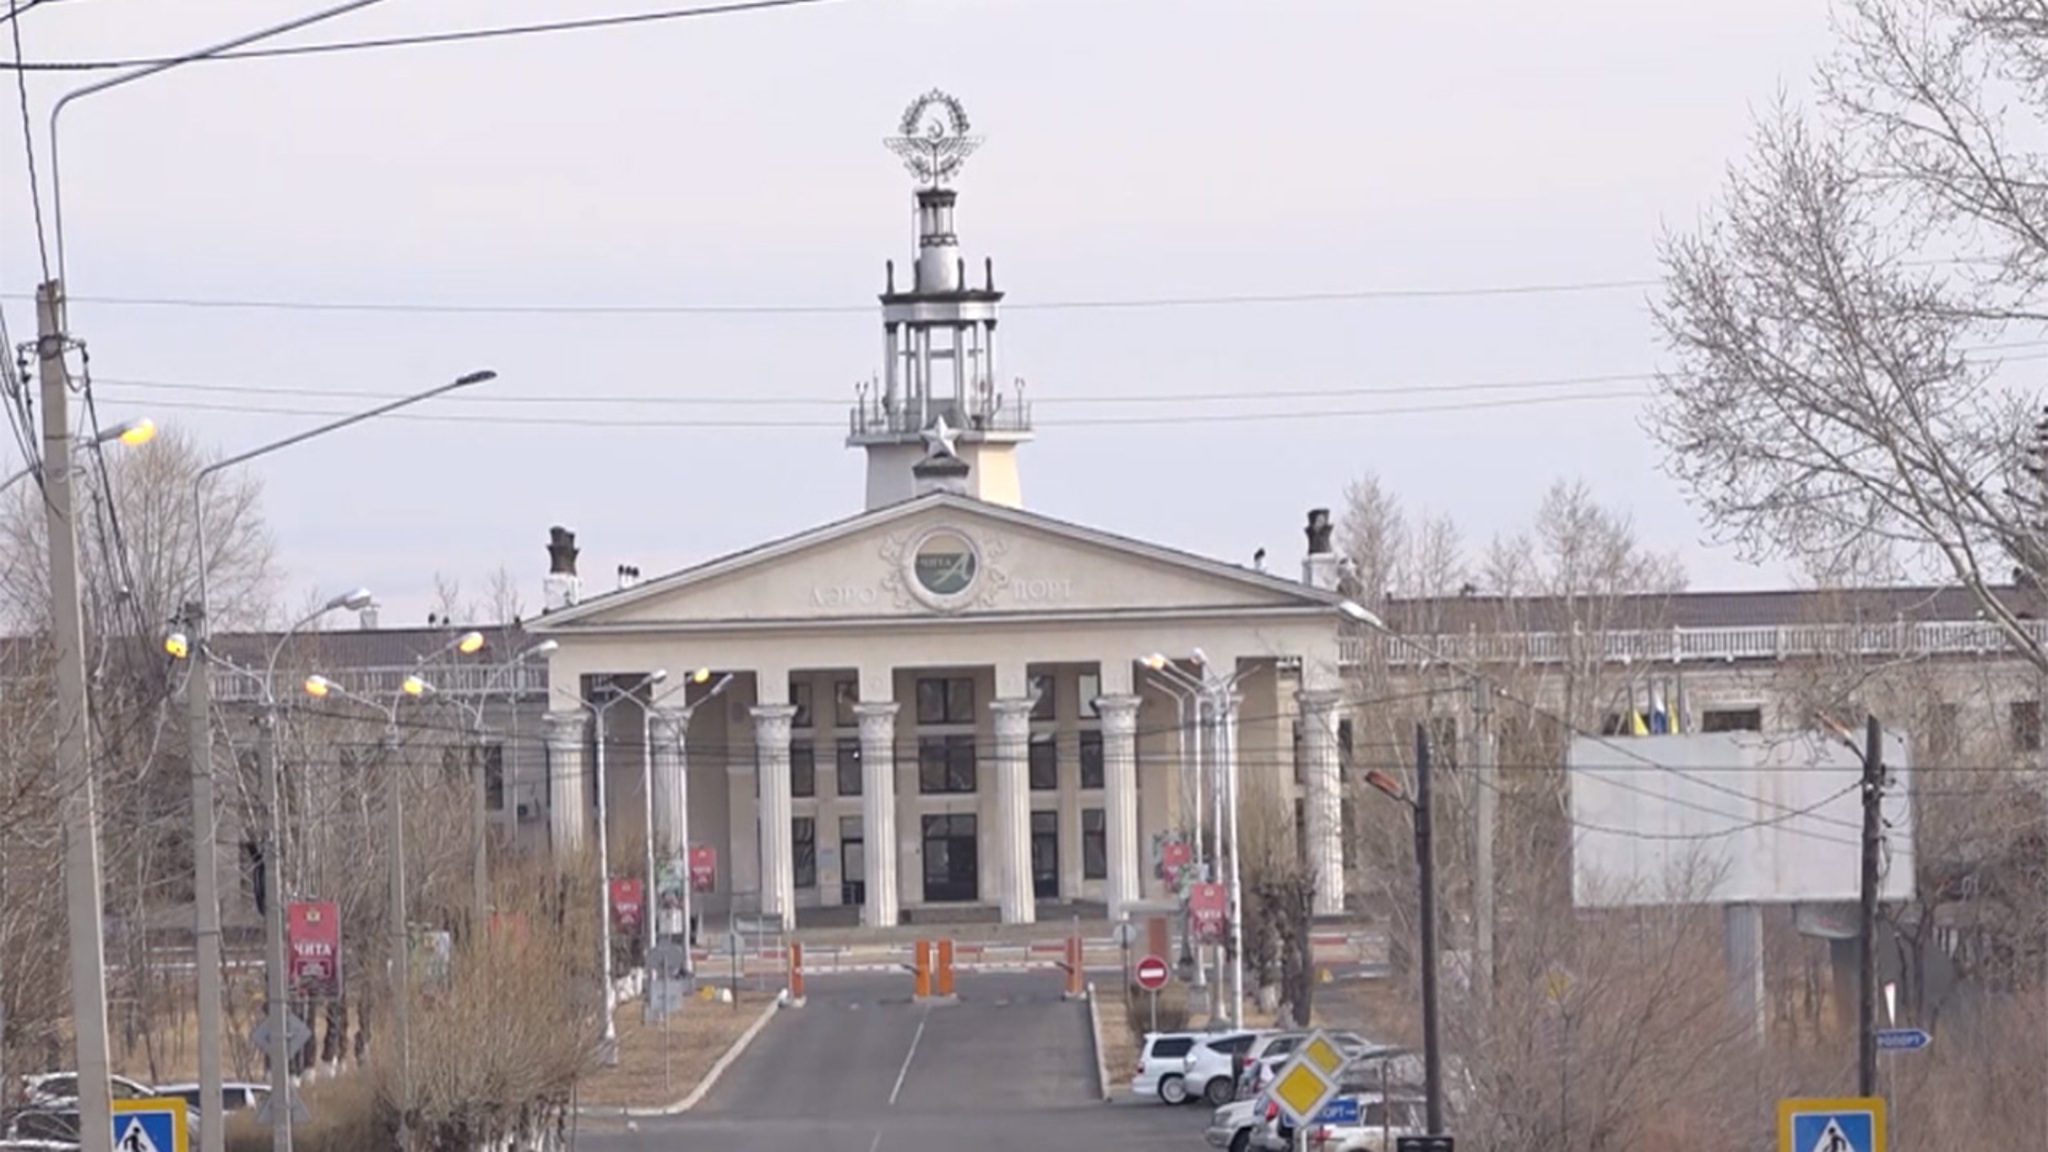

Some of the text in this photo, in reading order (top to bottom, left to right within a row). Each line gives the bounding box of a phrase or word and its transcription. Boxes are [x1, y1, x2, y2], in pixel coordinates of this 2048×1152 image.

[809, 586, 877, 607] АЭРО
[1012, 578, 1073, 600] ПОРТ
[293, 942, 332, 957] ЧИТА
